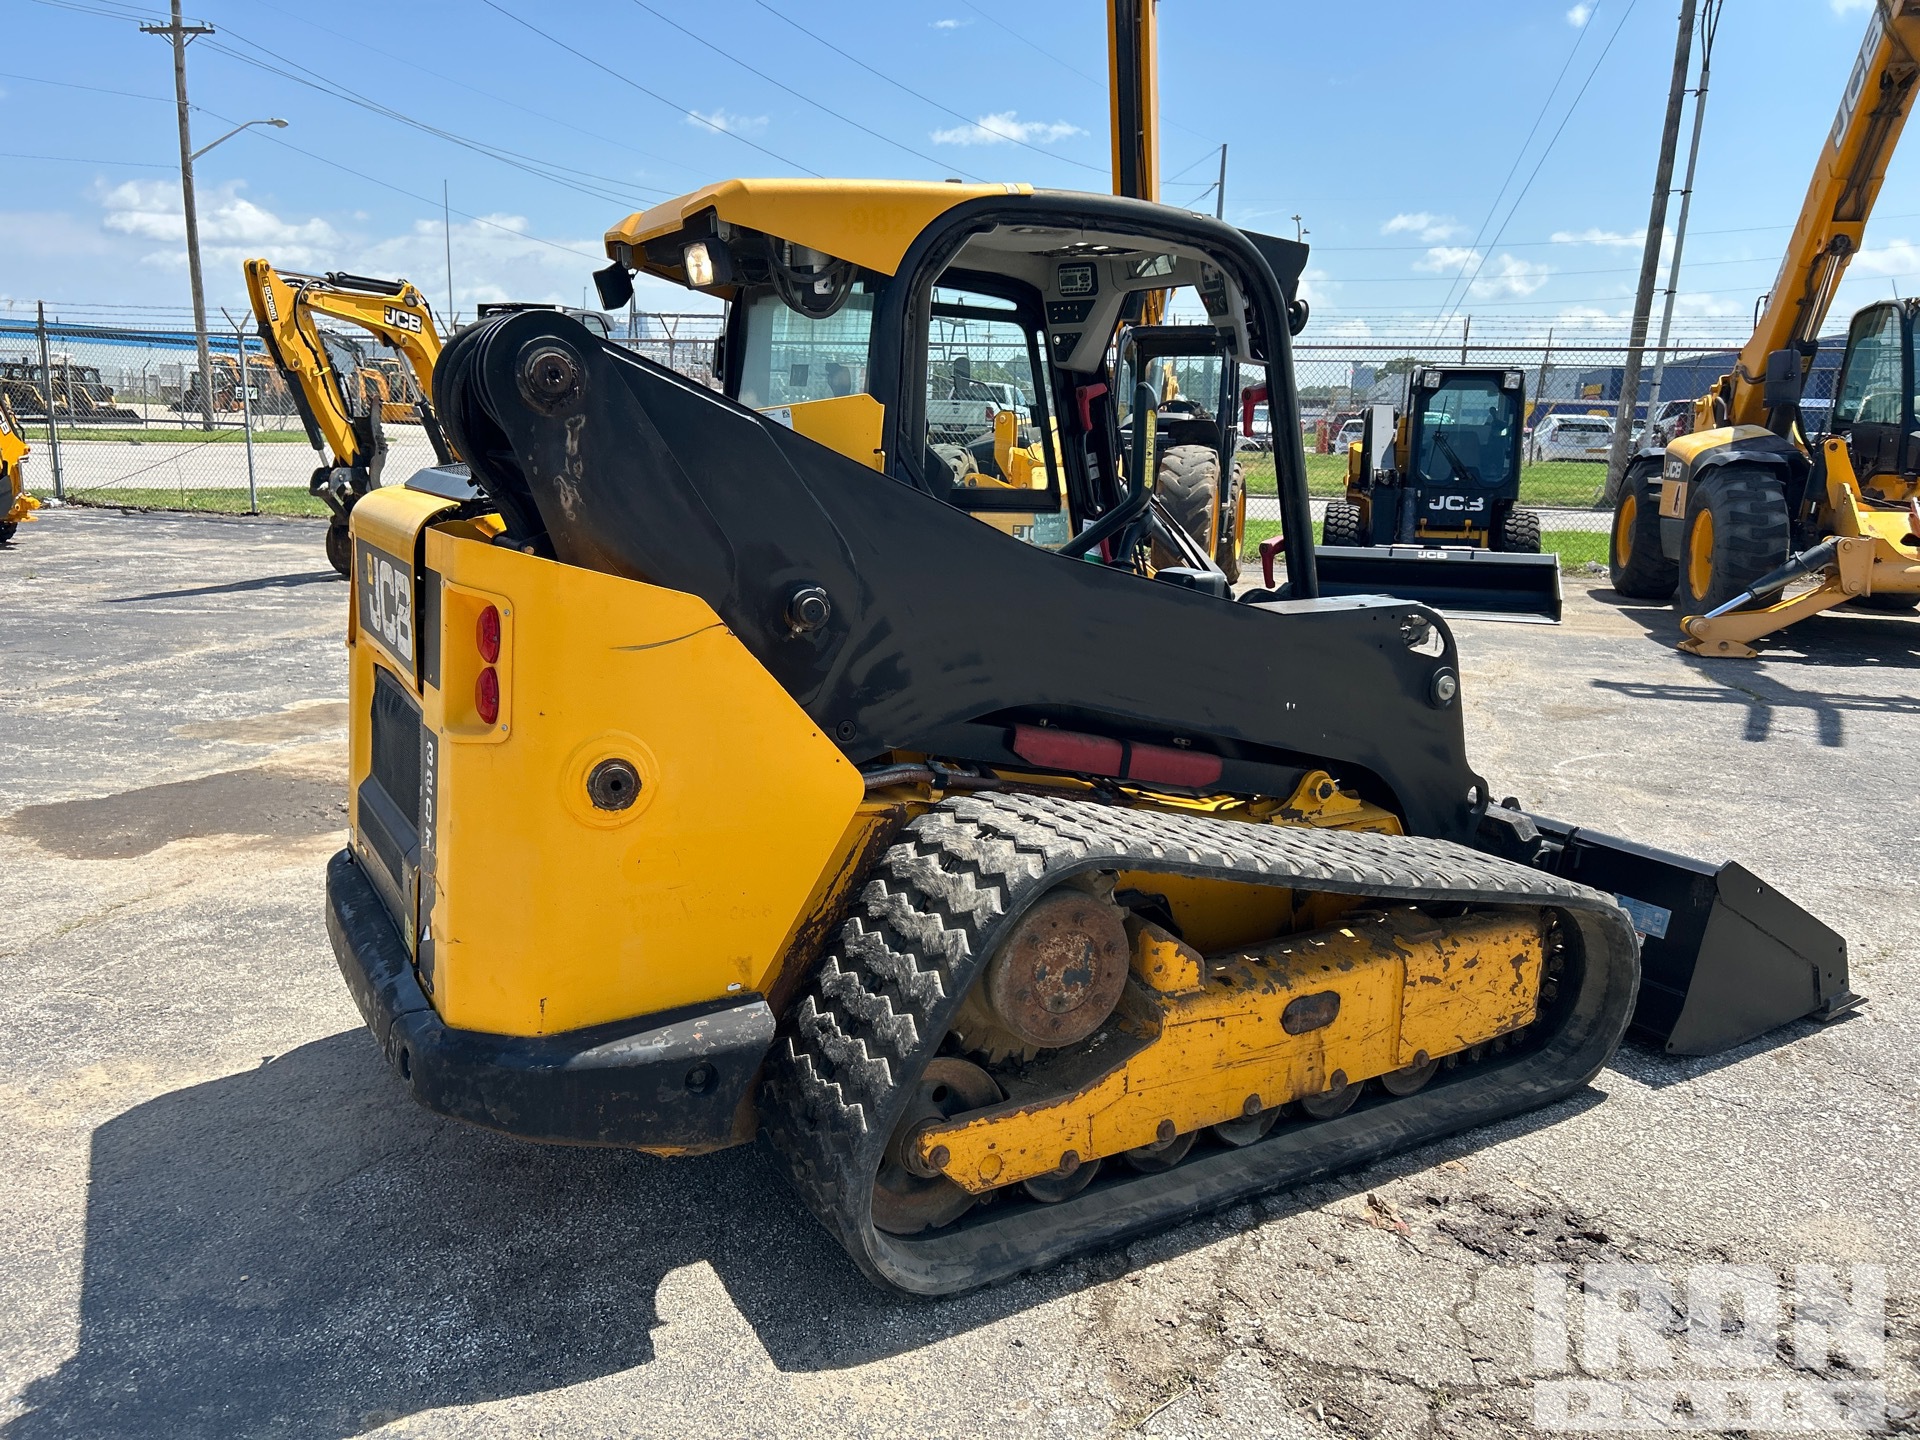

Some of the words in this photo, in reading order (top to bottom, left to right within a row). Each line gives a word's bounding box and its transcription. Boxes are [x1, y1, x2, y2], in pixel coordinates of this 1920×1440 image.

[1832, 11, 1883, 149] JCB
[385, 308, 422, 333] JCB
[1665, 461, 1682, 478] JCB
[1428, 495, 1484, 511] JCB
[1417, 551, 1448, 559] JCB
[367, 554, 413, 661] JCB
